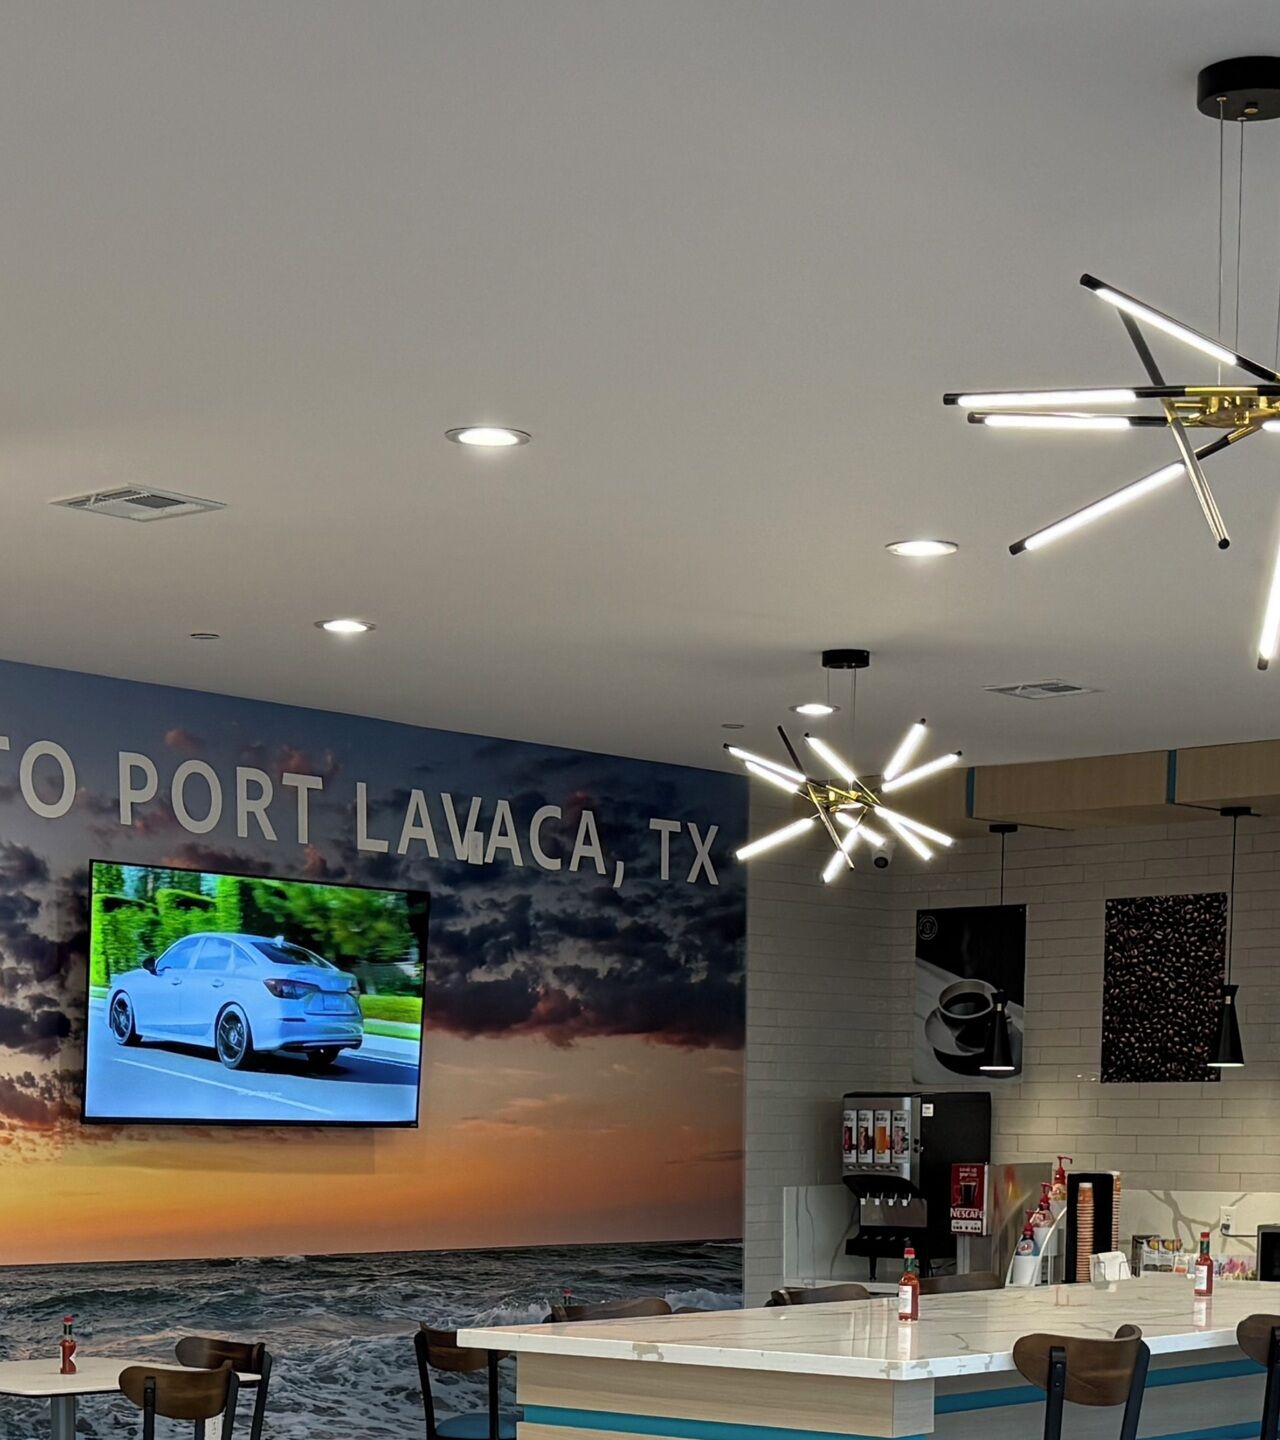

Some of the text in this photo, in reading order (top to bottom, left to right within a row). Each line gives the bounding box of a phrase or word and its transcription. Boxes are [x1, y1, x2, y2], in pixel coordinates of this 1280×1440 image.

[119, 751, 323, 844] PORT
[356, 782, 624, 888] LAVACA,
[649, 818, 719, 885] TX
